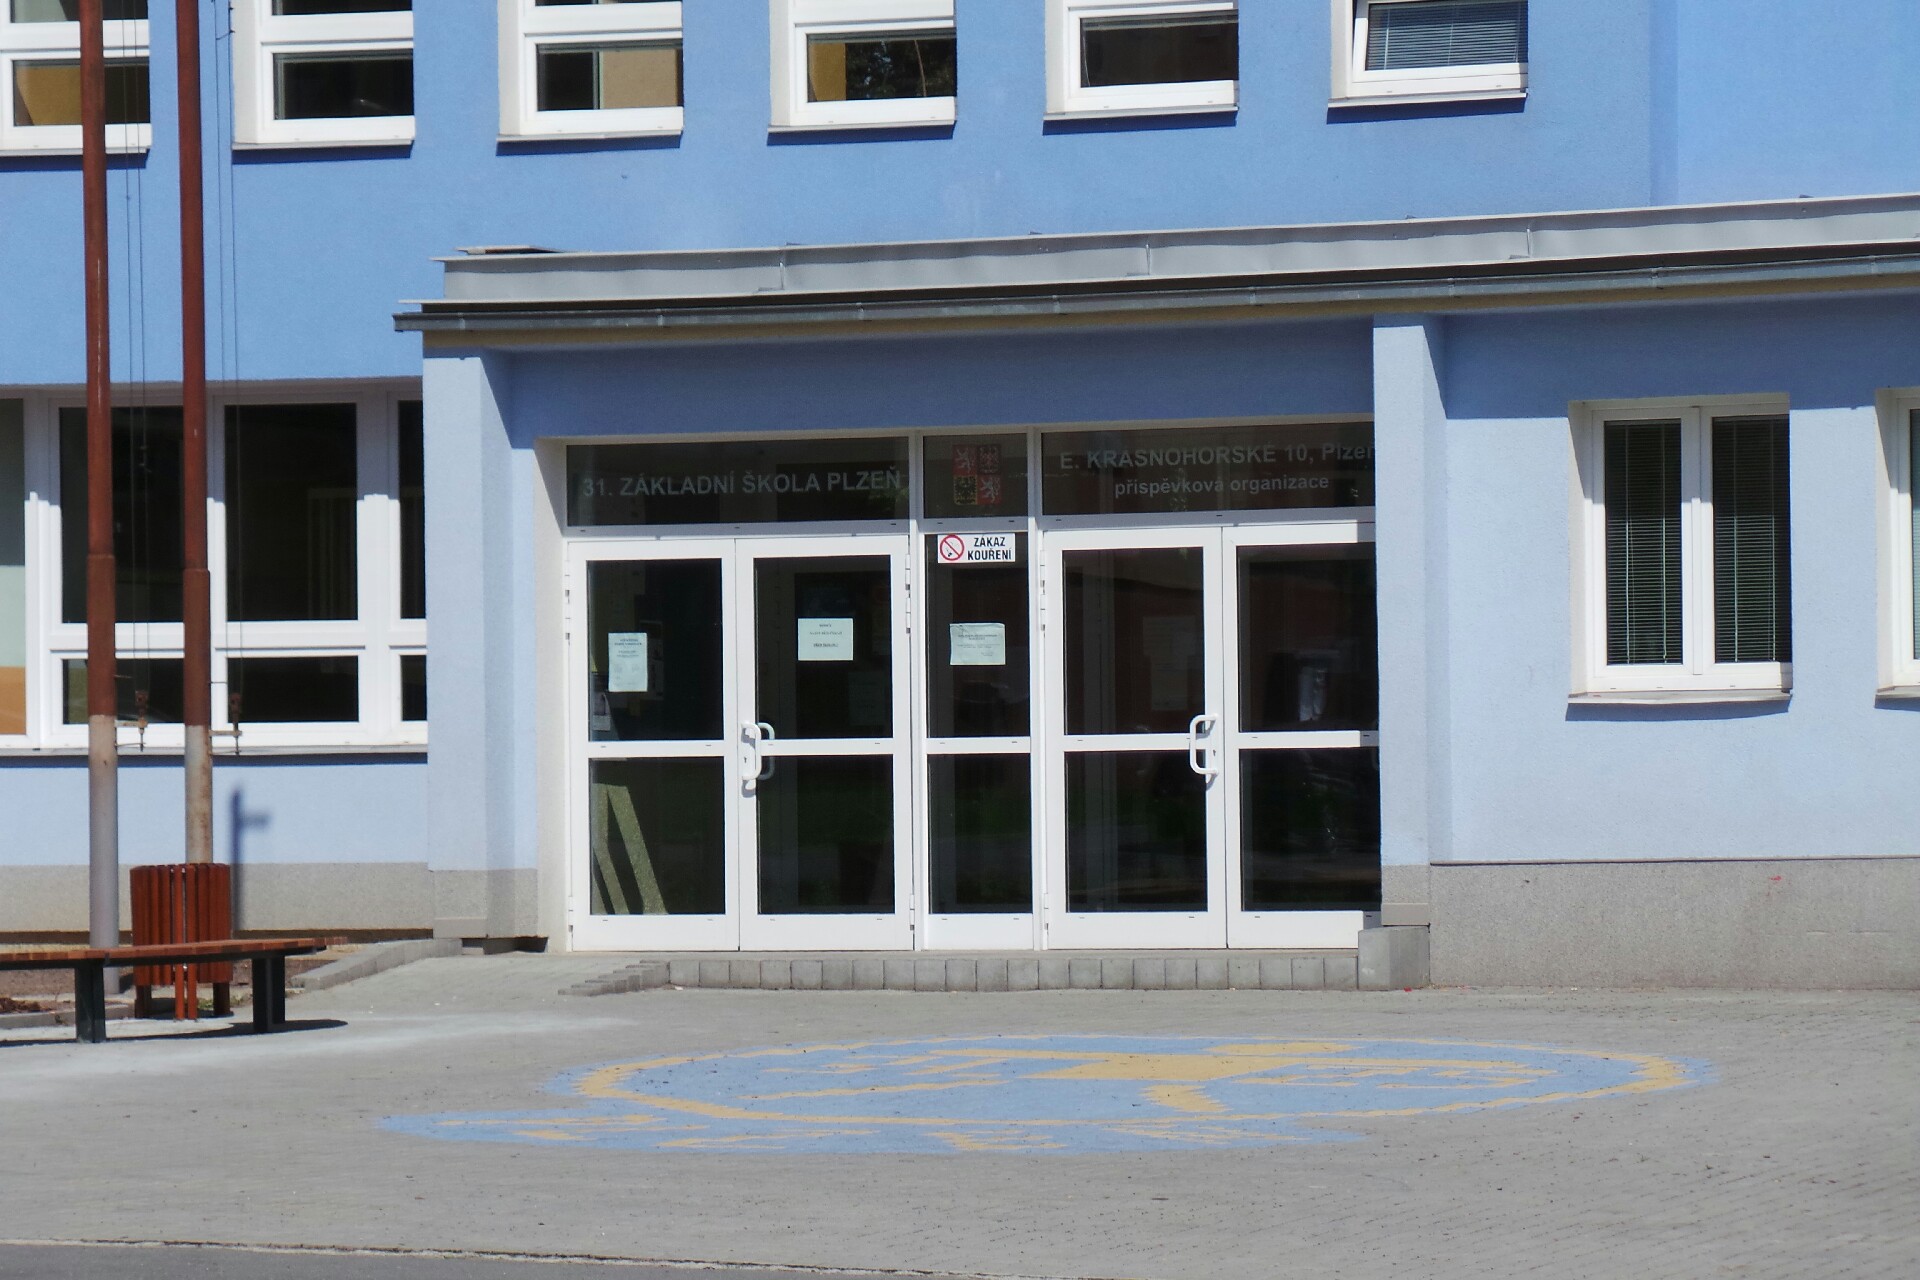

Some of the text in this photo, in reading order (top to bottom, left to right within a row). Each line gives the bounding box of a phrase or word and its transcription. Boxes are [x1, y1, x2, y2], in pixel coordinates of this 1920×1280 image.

[1060, 450, 1079, 471] E.
[1284, 443, 1314, 465] 10,
[582, 465, 902, 497] 31. ZÁKLADNÍ ŠKOLA PLZEŇ
[1230, 473, 1329, 494] organizace
[973, 534, 1006, 547] ZÁKAZ
[967, 547, 1012, 561] KOUŘENÍ
